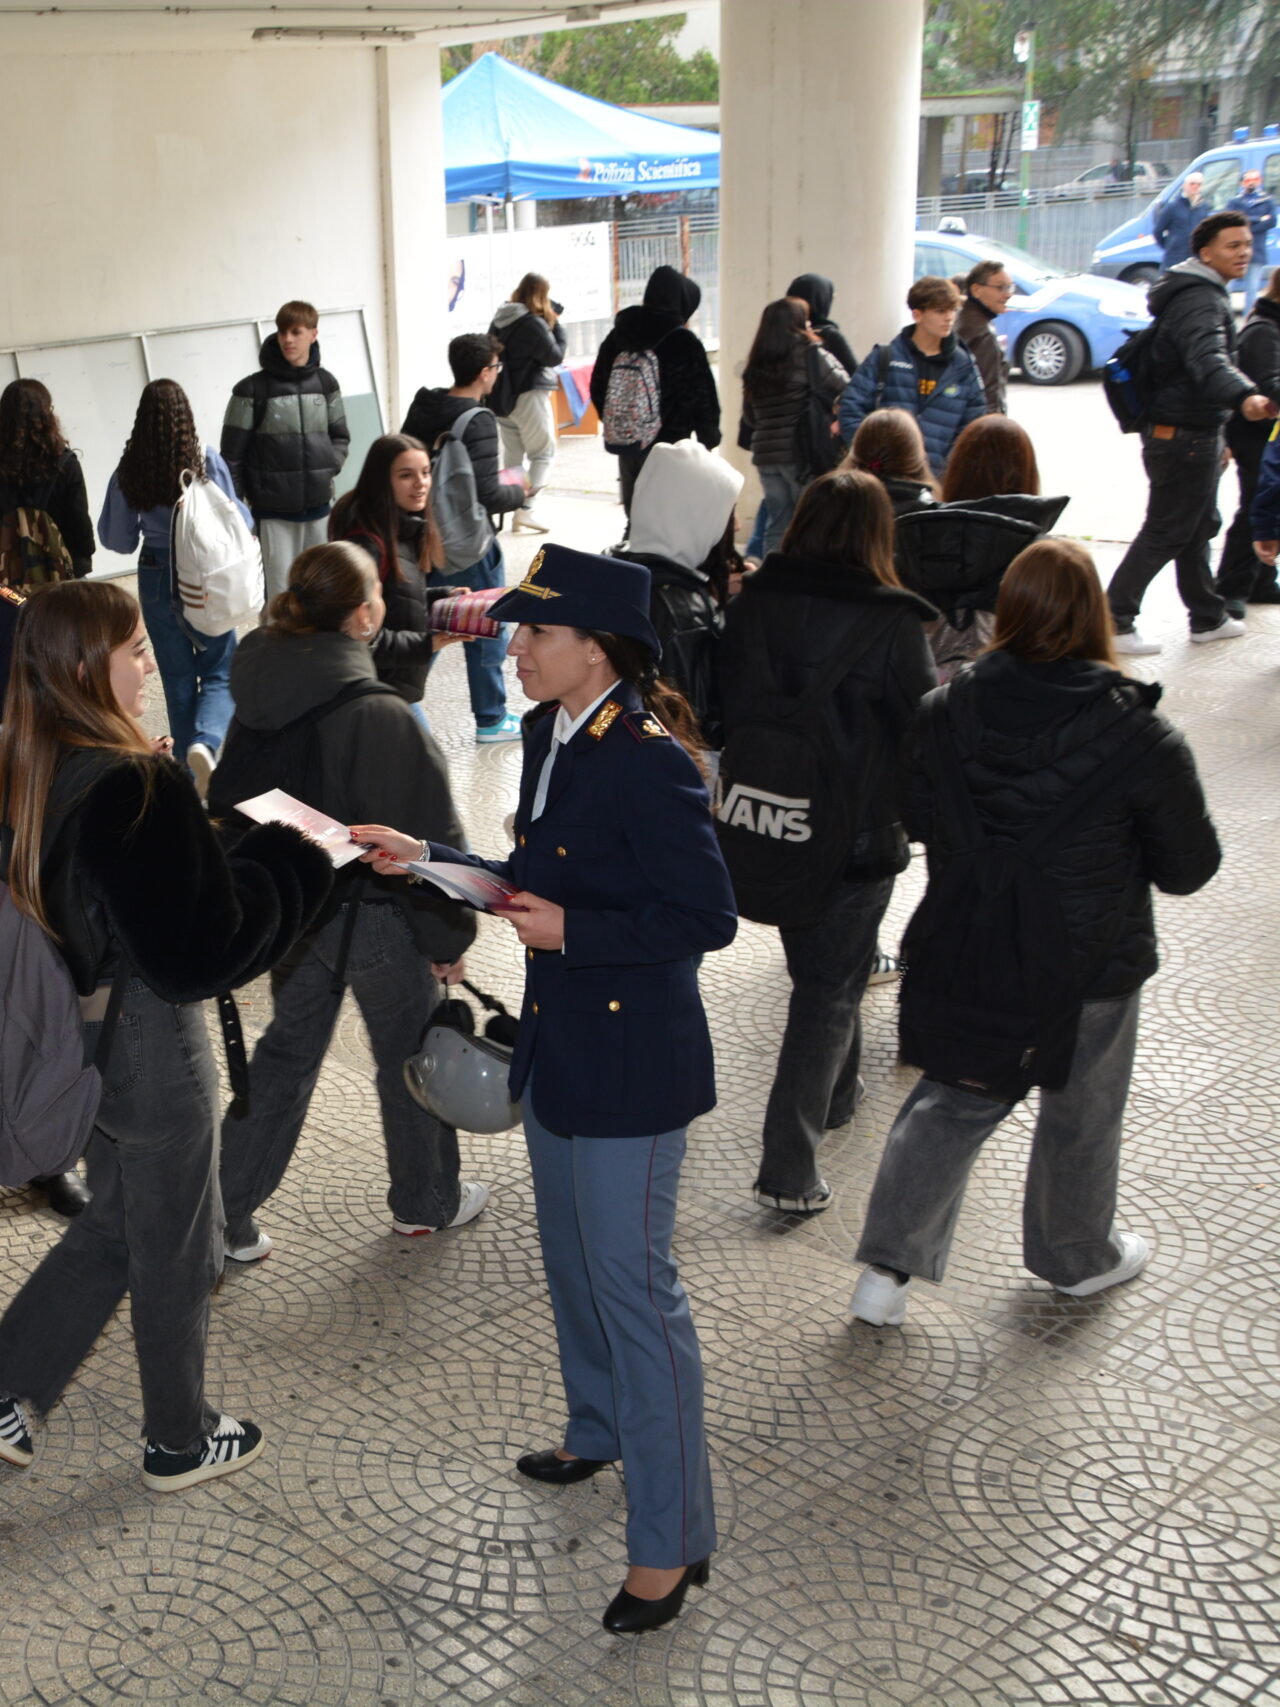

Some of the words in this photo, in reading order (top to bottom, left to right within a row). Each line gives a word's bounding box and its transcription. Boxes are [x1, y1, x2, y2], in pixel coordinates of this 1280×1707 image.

[593, 162, 635, 183] Polizia
[637, 158, 702, 182] Scientifica
[717, 783, 813, 843] VANS
